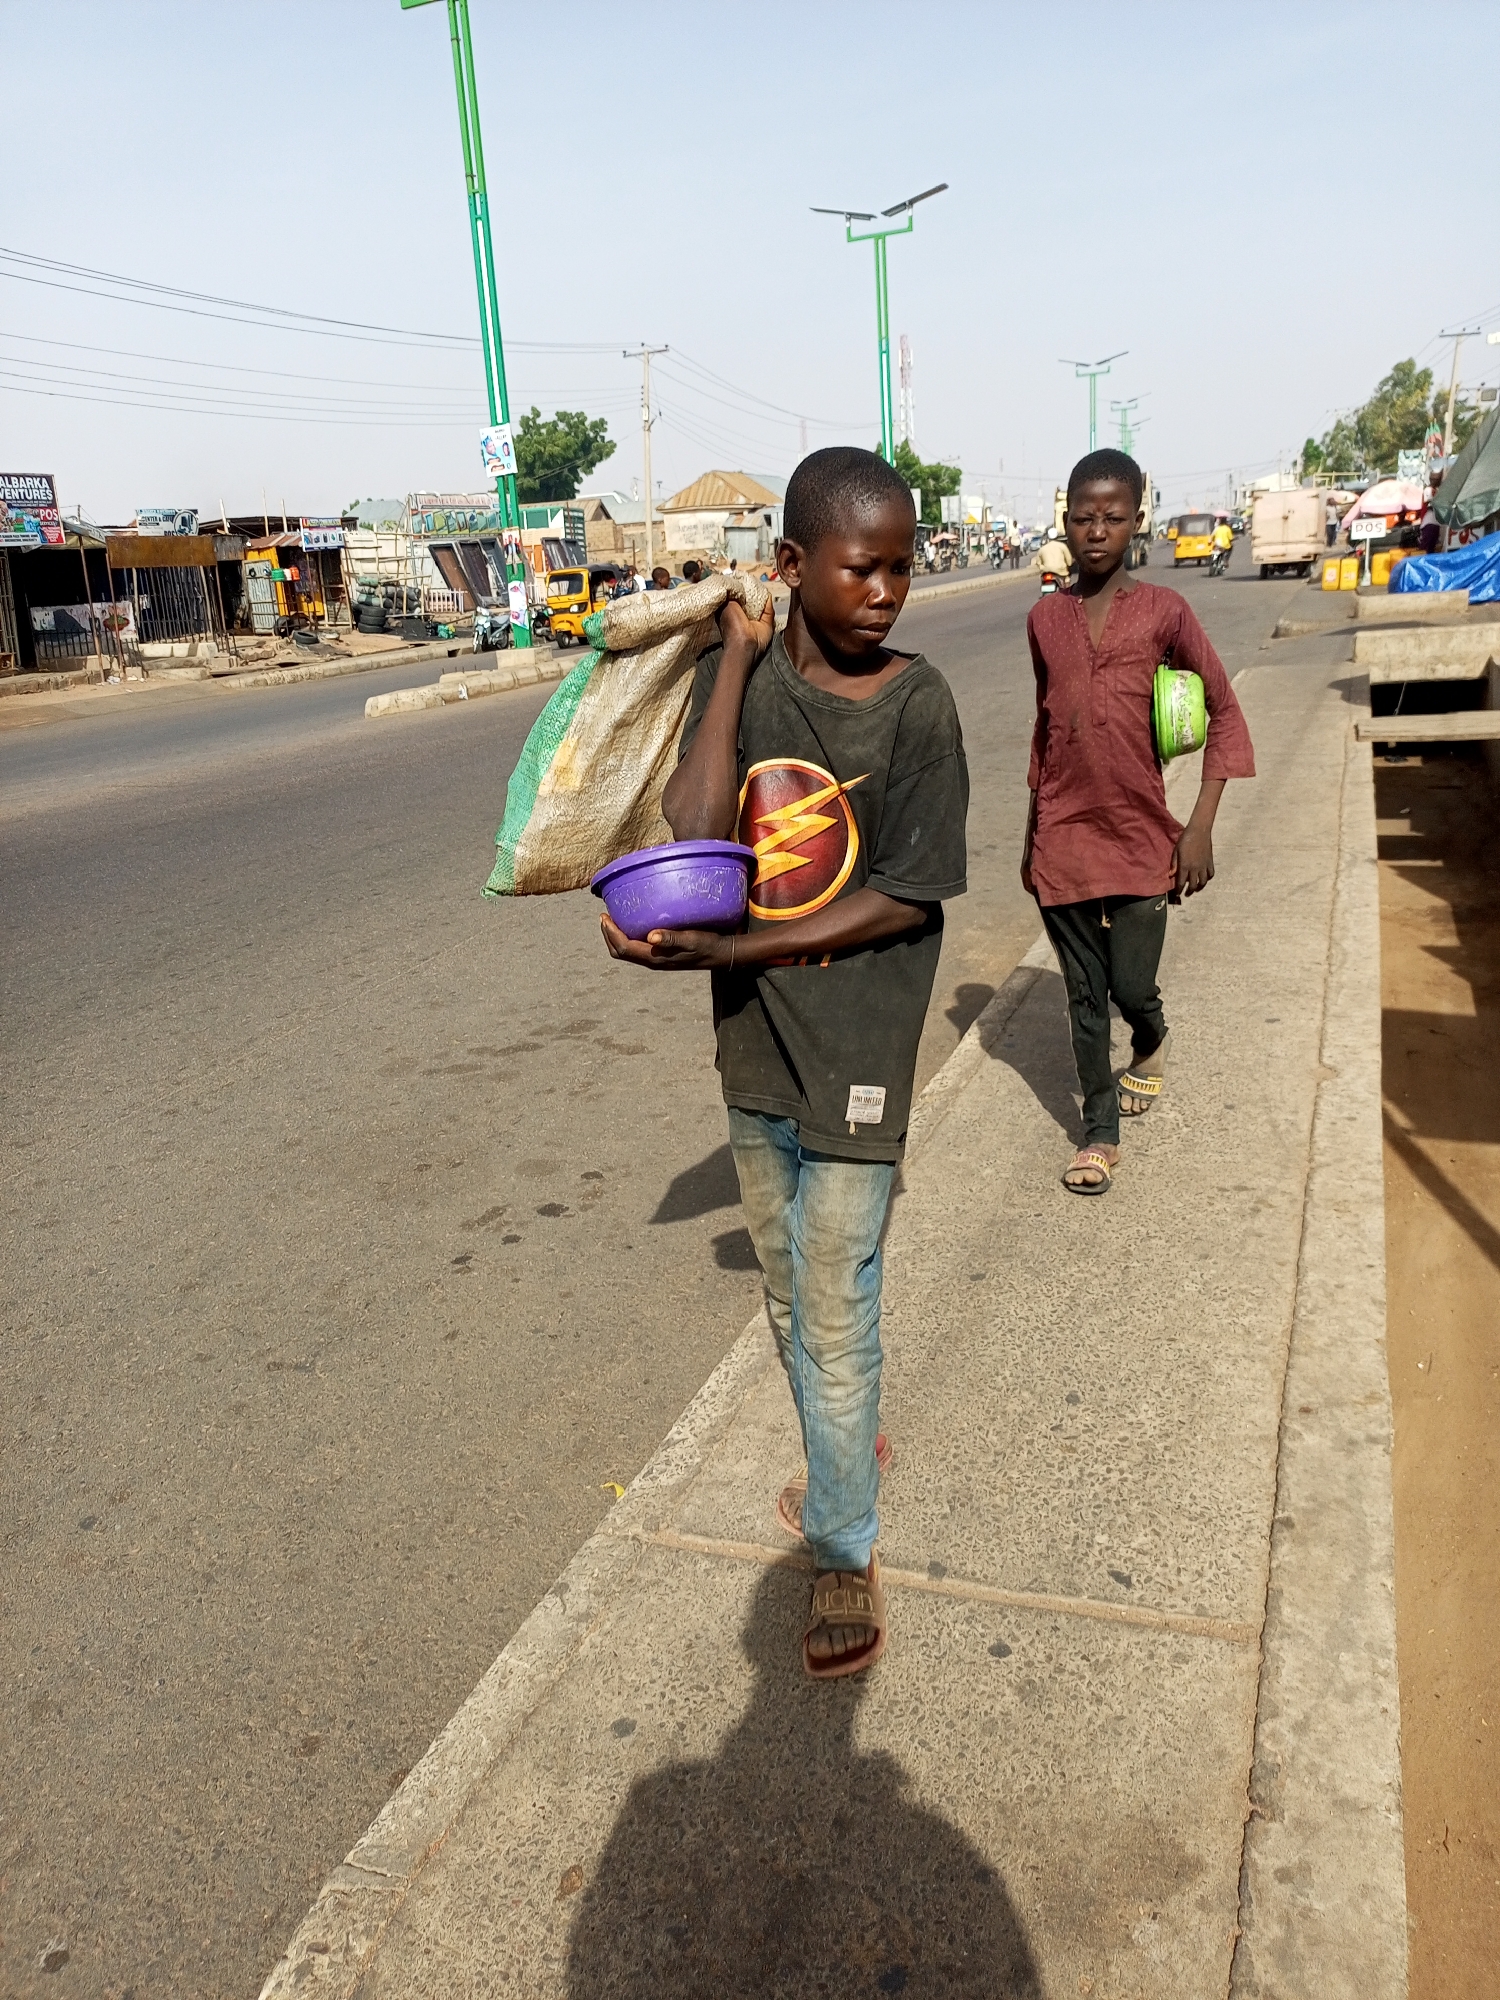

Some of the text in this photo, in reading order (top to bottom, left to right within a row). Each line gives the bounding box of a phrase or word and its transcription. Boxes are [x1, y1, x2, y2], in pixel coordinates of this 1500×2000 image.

[0, 476, 50, 489] ALBARKA
[0, 488, 53, 500] VENTURES
[40, 508, 58, 521] POS
[1355, 522, 1384, 533] POS
